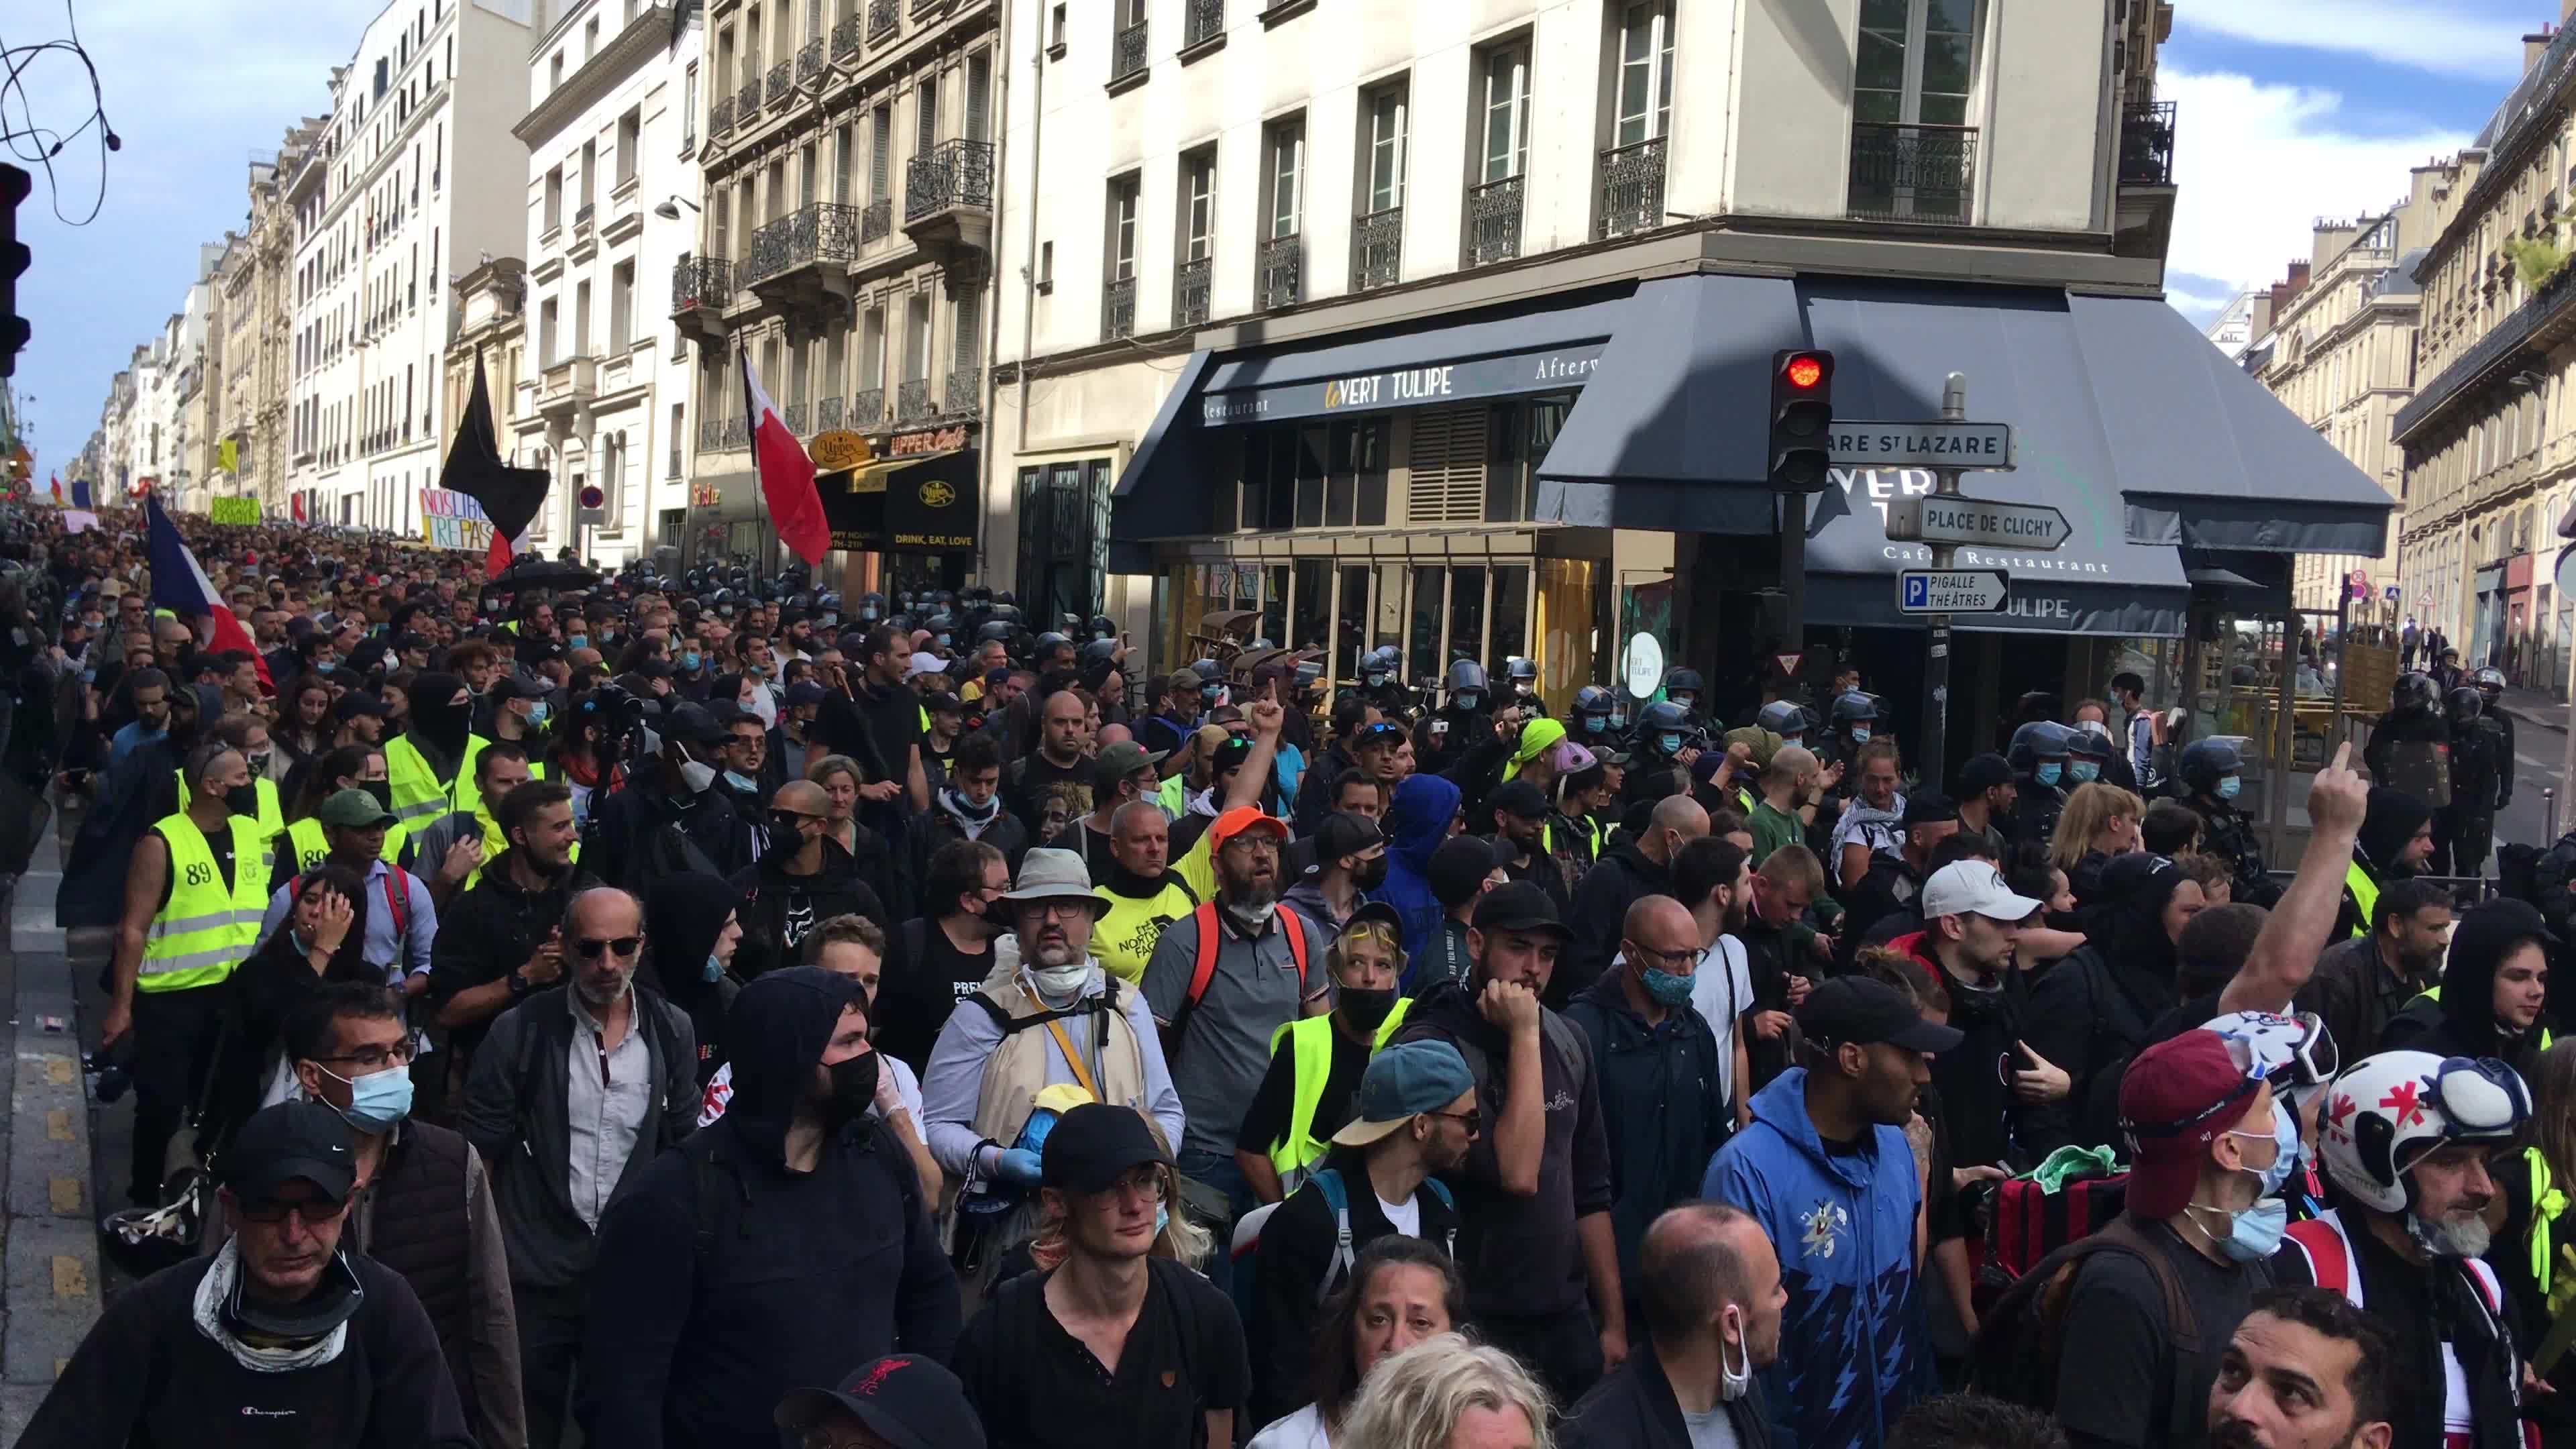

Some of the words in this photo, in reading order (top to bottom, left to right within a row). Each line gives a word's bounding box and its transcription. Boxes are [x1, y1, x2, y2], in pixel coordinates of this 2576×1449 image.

[1339, 375, 1382, 405] VERT
[1392, 366, 1454, 400] TULIPE
[891, 431, 935, 456] UPPER
[1826, 435, 1870, 452] ARE
[1907, 436, 1998, 454] LAZARE
[1829, 468, 1932, 498] VER
[421, 489, 453, 516] NOS
[1927, 509, 1975, 531] PLACE
[1980, 515, 1998, 533] DE
[2004, 517, 2053, 537] CLICHY
[949, 536, 972, 546] LOVE
[1966, 551, 2110, 573] Restaurant
[1910, 580, 1923, 603] P
[1929, 576, 1976, 589] PIGALLE
[1997, 597, 2070, 619] ULIPE
[185, 861, 211, 885] 89
[1118, 927, 1160, 953] NORTH
[1135, 941, 1156, 959] FAC
[241, 1406, 296, 1418] Champion
